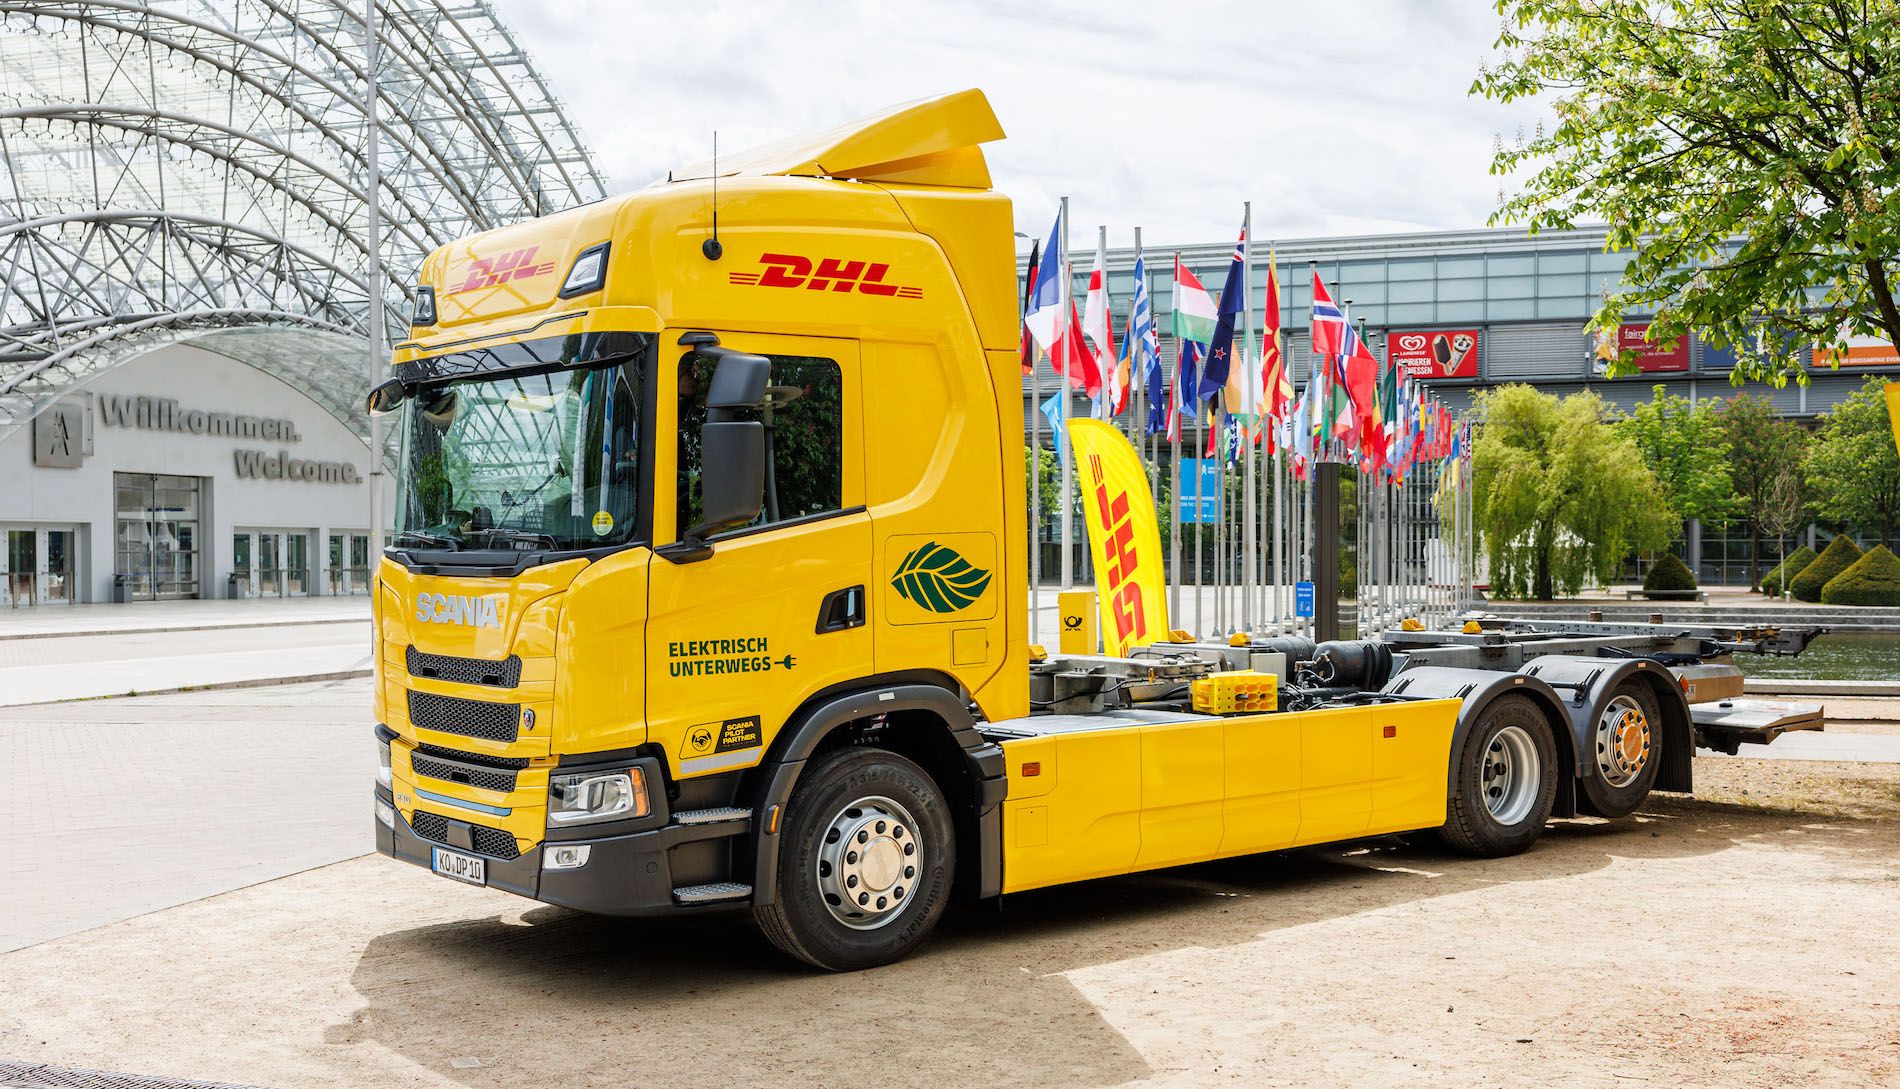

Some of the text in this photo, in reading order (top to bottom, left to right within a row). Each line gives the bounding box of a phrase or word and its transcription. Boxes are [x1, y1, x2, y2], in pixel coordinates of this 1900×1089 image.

[461, 245, 539, 292] DHL
[758, 253, 898, 296] DHL
[100, 394, 302, 442] Willkommen.
[234, 450, 362, 484] Welcome.
[1096, 483, 1146, 643] DHL
[416, 592, 499, 629] SCANIA
[669, 637, 768, 657] ELEKTRISCH
[670, 656, 771, 677] UNTERWEGS
[723, 733, 756, 744] PARTNER
[725, 729, 745, 738] PILOT
[727, 721, 754, 731] SCANIA
[440, 853, 481, 880] KO DP 10
